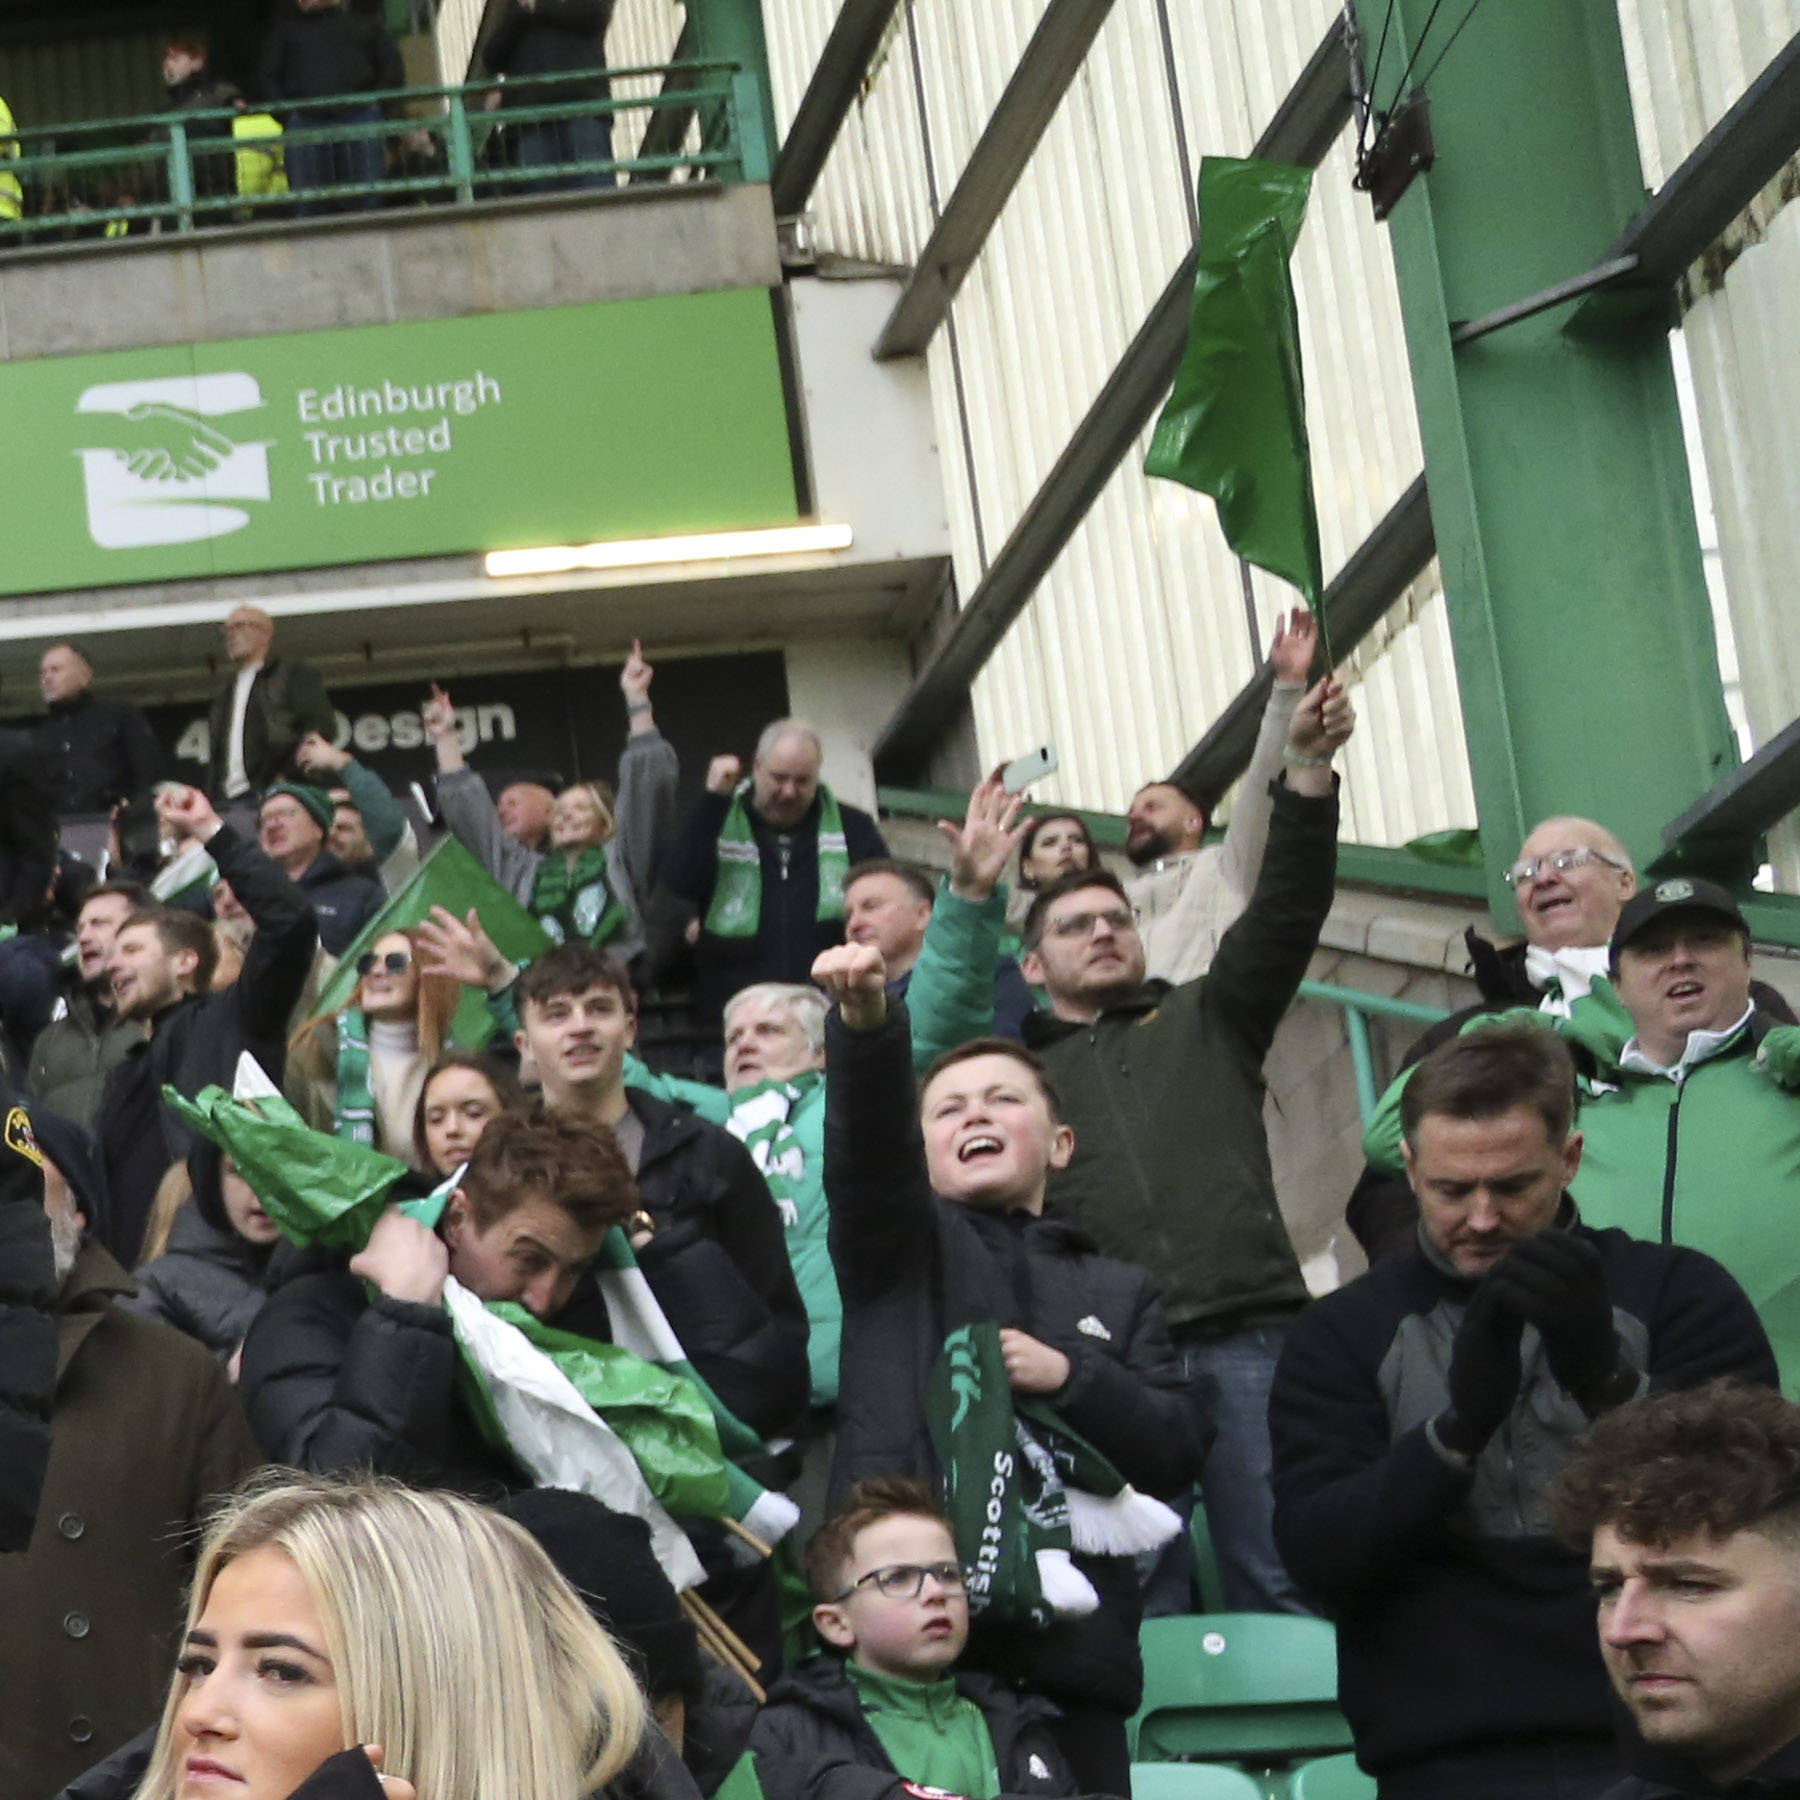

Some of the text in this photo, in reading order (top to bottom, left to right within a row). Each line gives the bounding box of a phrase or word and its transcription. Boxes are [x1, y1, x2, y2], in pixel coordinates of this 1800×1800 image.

[298, 369, 502, 423] Edinburgh
[303, 416, 451, 464] Trusted
[307, 463, 437, 507] Trader
[334, 702, 517, 755] esgn
